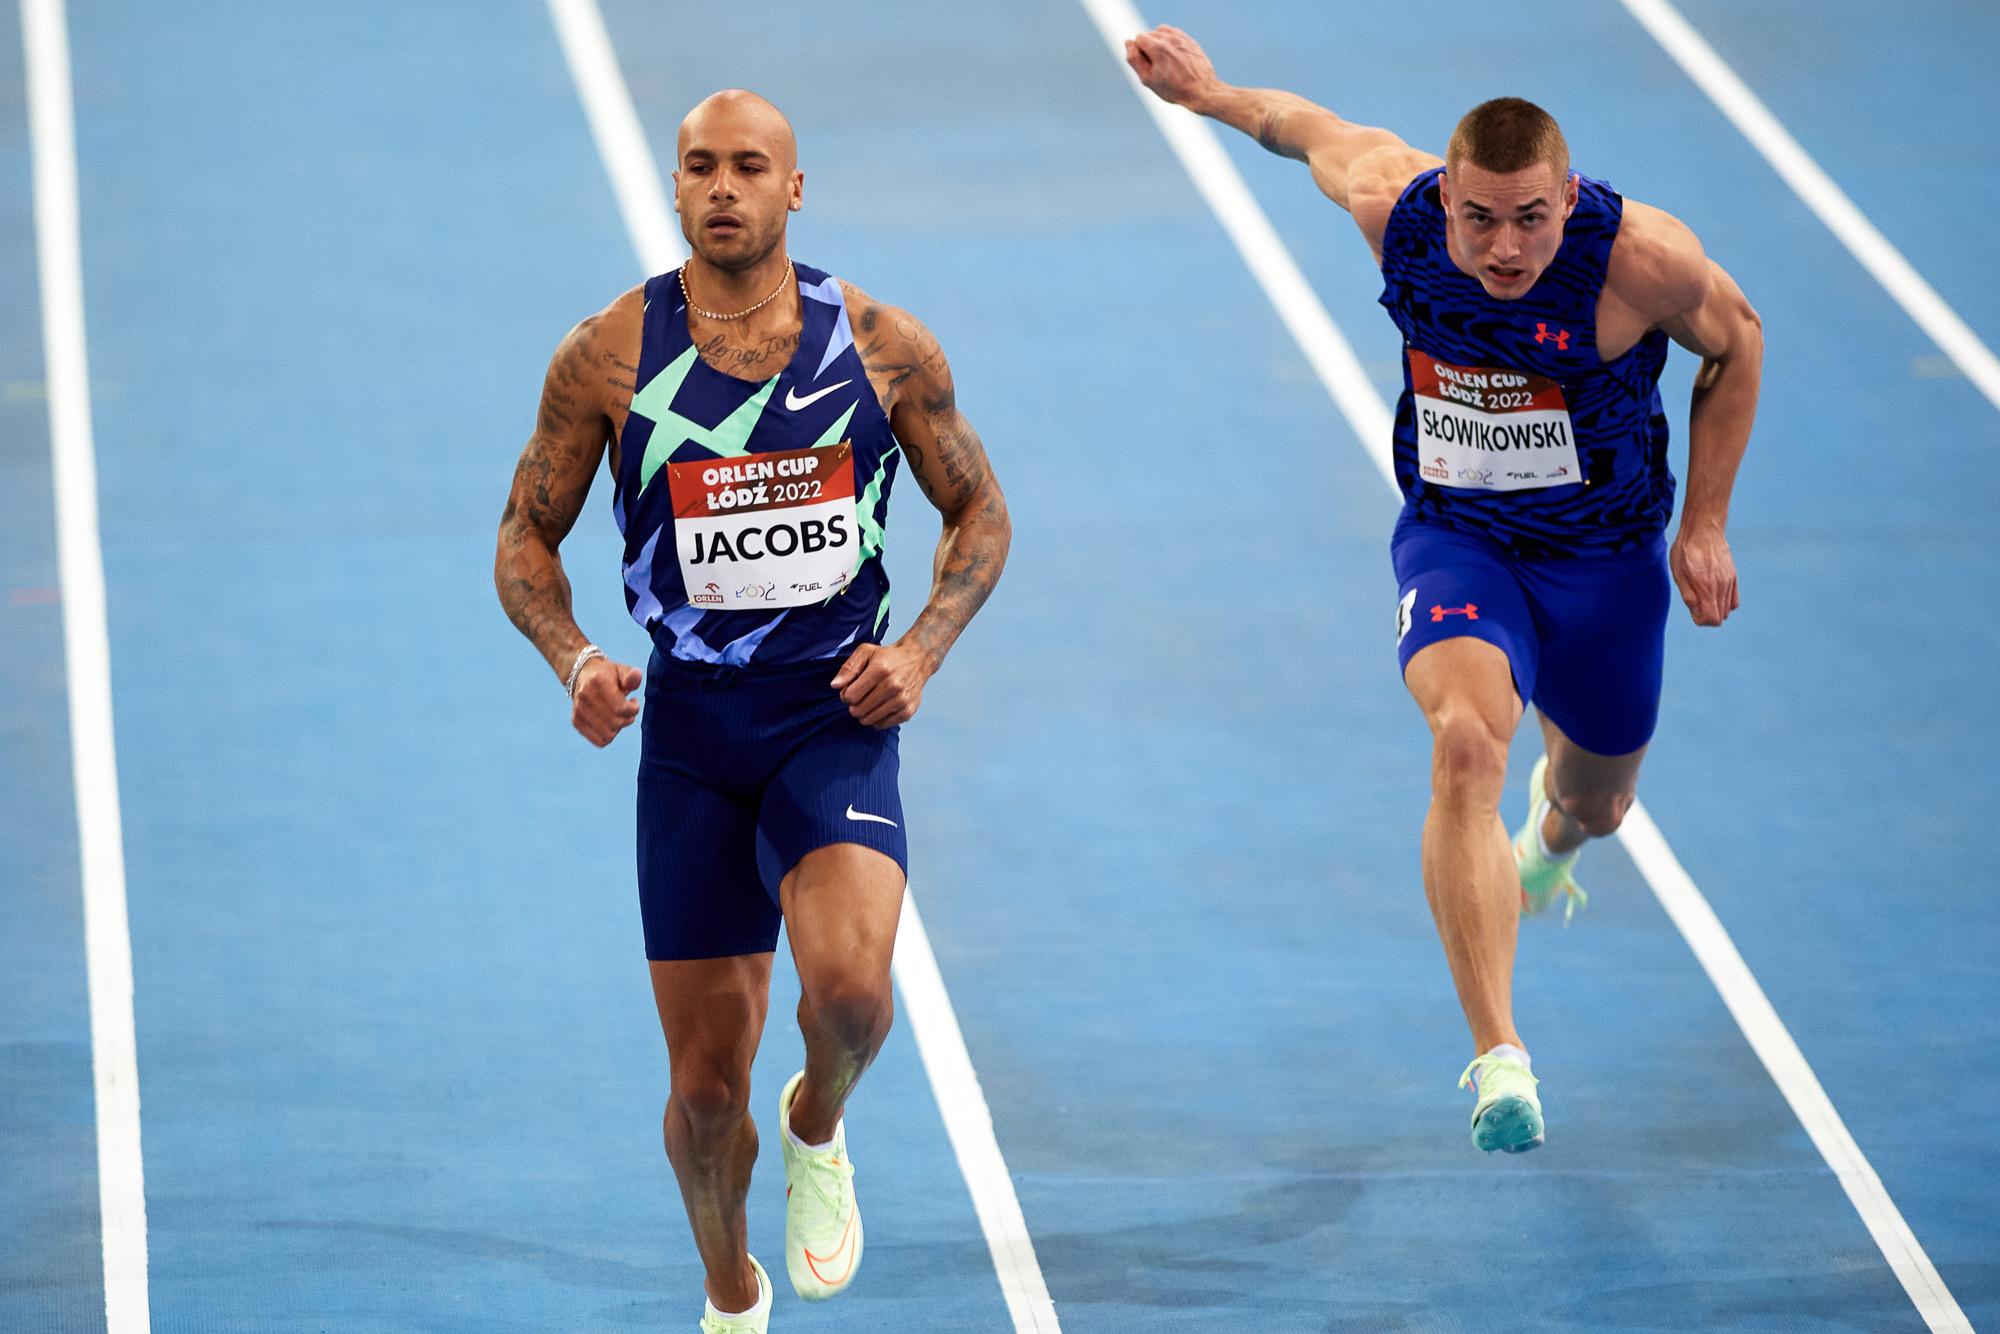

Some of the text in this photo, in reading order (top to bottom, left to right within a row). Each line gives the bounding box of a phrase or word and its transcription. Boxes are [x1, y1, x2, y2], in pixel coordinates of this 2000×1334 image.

[1434, 363, 1527, 389] ORLEN CUP
[1439, 381, 1534, 409] ŁÓDŹ 2022
[1423, 409, 1567, 452] SŁOWIKOWSKI
[702, 456, 819, 486] ORLEN CUP
[706, 480, 822, 510] ŁÓDŹ 2022
[690, 515, 848, 564] JACOBS
[694, 595, 724, 603] ORLEN
